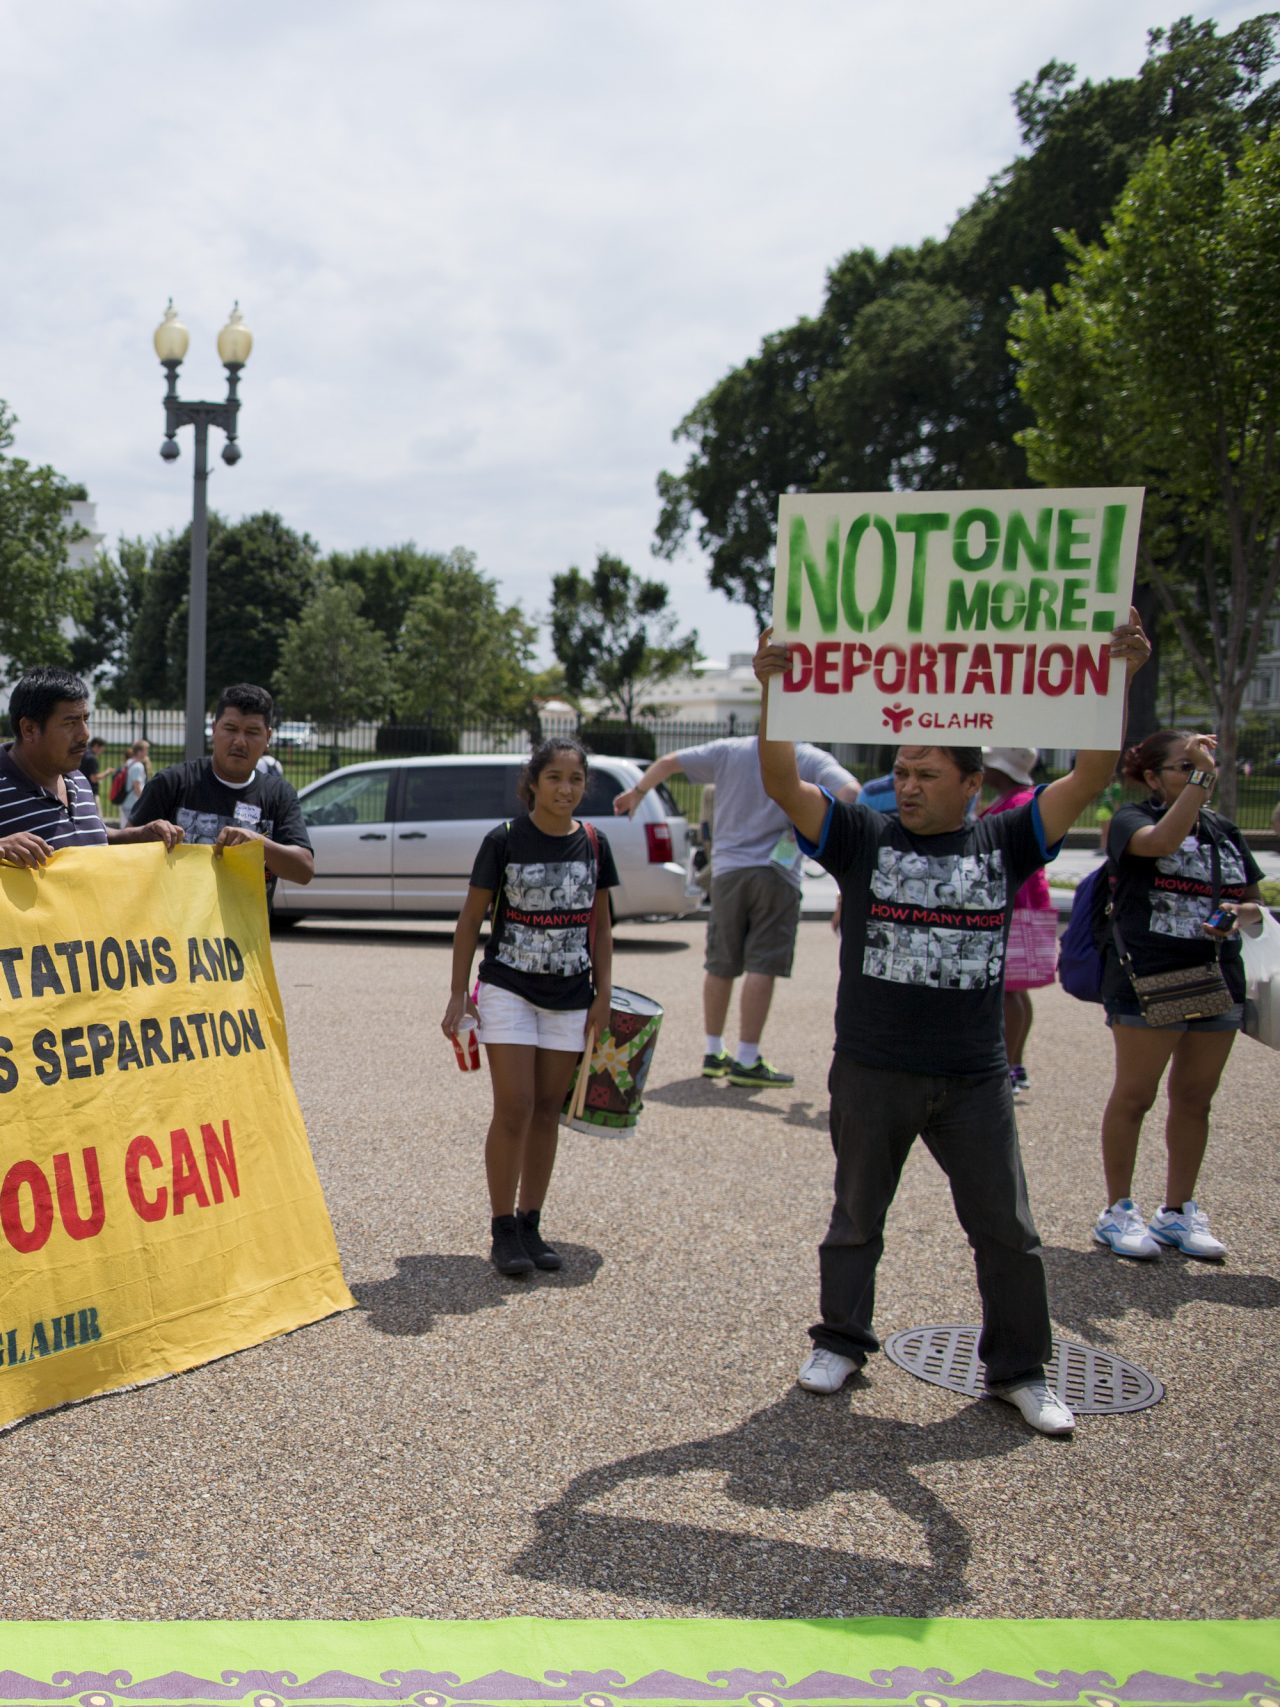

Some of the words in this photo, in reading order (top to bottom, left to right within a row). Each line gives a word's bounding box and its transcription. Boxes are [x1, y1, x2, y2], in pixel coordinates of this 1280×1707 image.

[785, 511, 951, 634] NOT
[783, 642, 1111, 697] DEPORTATION
[917, 711, 994, 731] GLAHR
[1154, 876, 1192, 892] HOW
[533, 914, 572, 925] MANY
[871, 904, 909, 920] HOW
[912, 910, 963, 925] MANY
[189, 936, 245, 982] AND
[33, 1008, 266, 1085] SEPARATION
[125, 1119, 239, 1222] CAN
